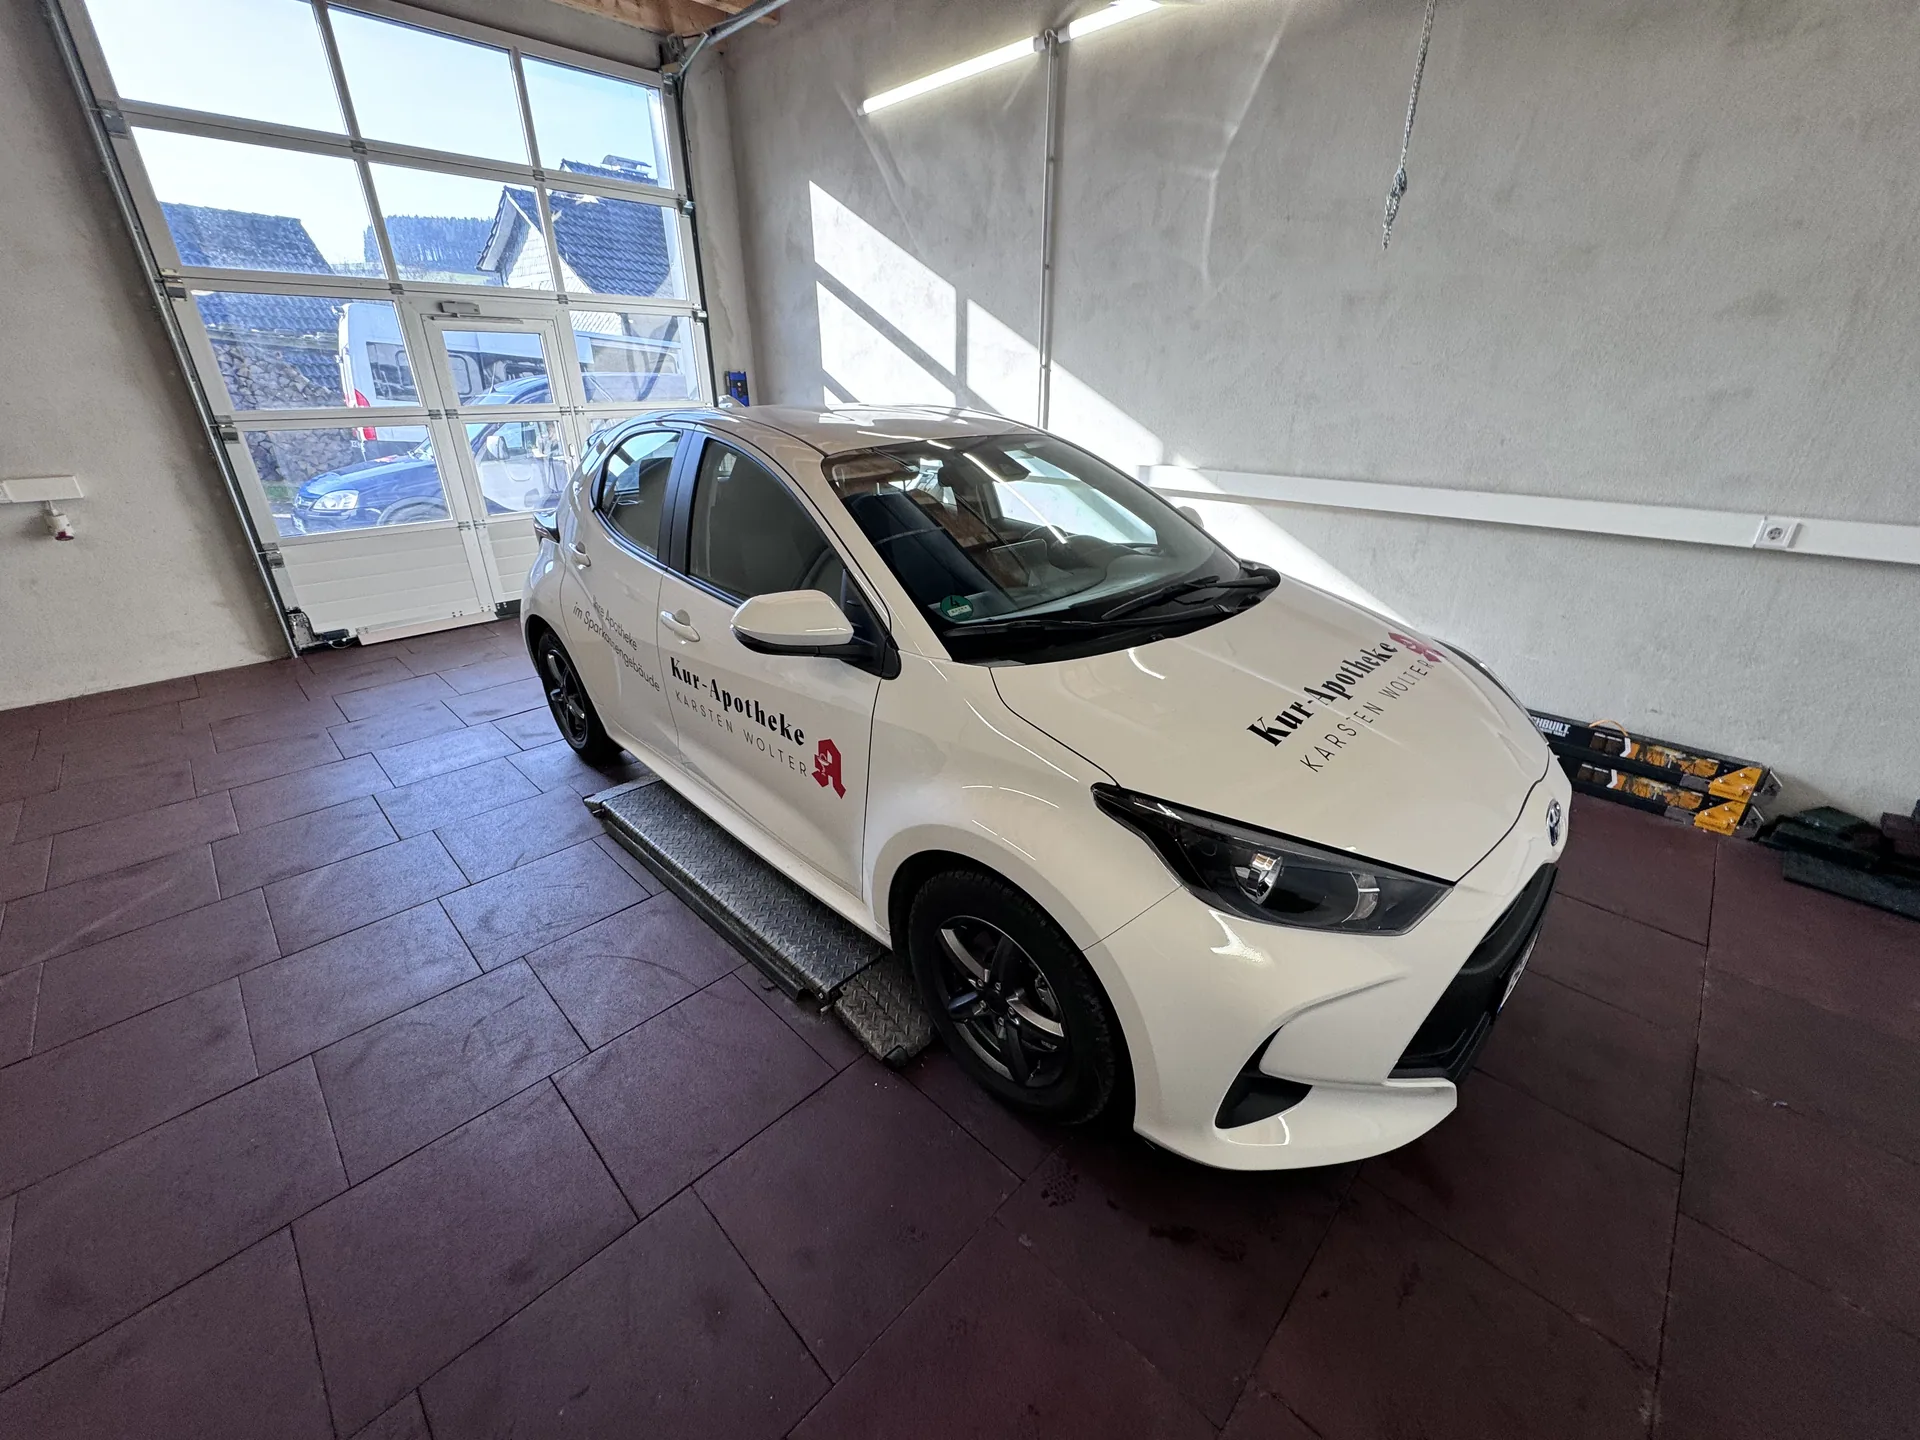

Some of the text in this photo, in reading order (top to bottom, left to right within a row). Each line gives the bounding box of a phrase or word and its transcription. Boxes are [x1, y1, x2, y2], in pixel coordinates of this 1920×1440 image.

[572, 602, 583, 620] im
[605, 609, 638, 651] Apotheke
[670, 656, 806, 746] Kur-Apotheke
[675, 690, 808, 778] KARSTEN WOLTER
[1246, 642, 1398, 748] Kur-Apotheke
[1299, 659, 1435, 773] KARSTEN WOLTER
